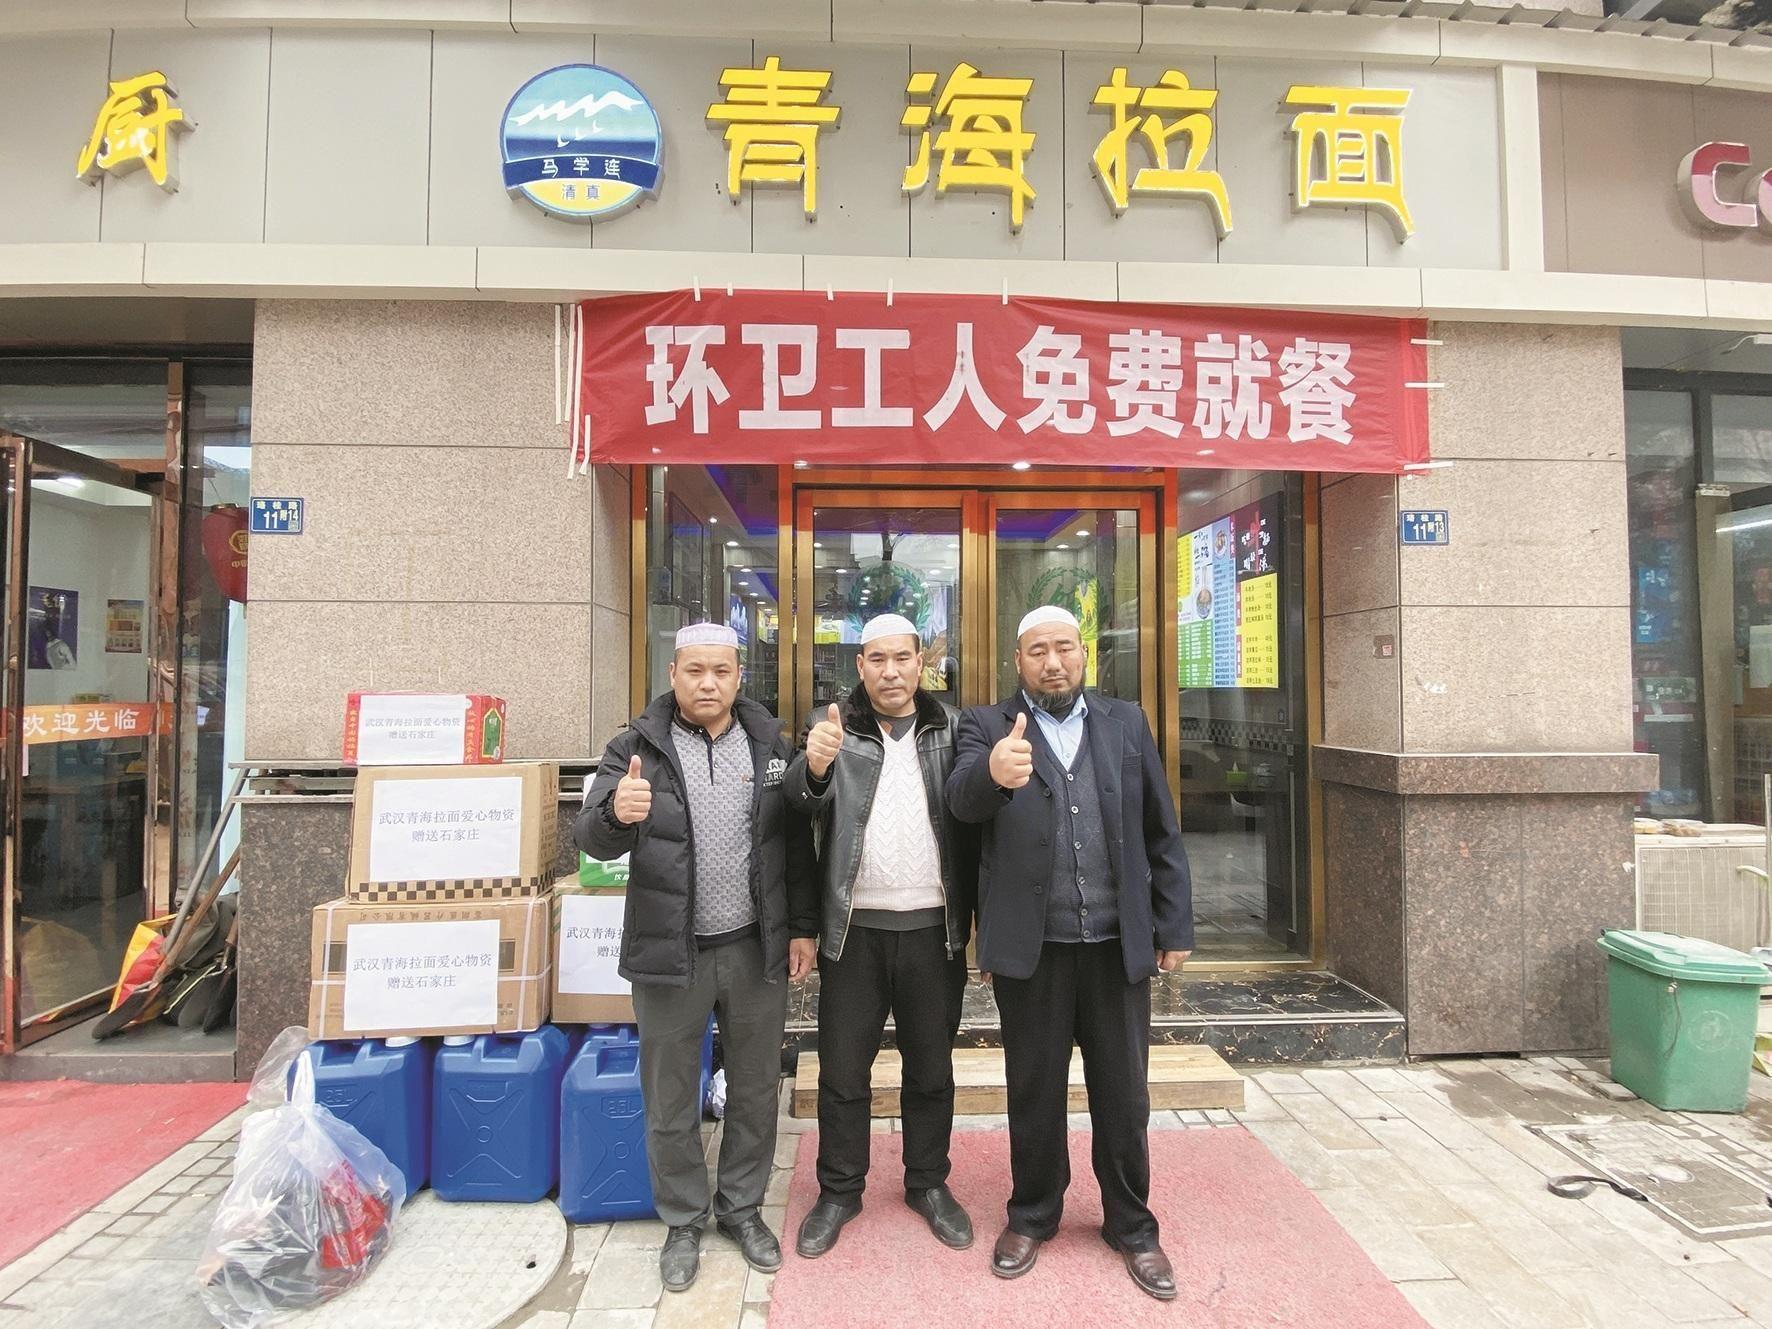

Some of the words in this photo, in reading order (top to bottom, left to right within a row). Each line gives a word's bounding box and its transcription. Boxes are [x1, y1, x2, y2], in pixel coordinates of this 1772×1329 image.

[78, 71, 183, 185] 厨
[705, 56, 1414, 238] 青海拉面
[541, 156, 621, 180] 马学连
[561, 184, 601, 201] 清真
[645, 322, 1357, 445] 环卫工人免费就餐
[23, 708, 140, 737] 欢迎光临
[365, 717, 461, 728] 武汉青海拉面爱心物资
[388, 730, 436, 740] 赠送石家庄
[379, 808, 515, 825] 武汉青海拉面爱心物资
[411, 828, 480, 843] 赠送石家庄
[353, 953, 492, 972] 武汉青海拉面爱心物资
[387, 974, 457, 990] 赠送石家庄
